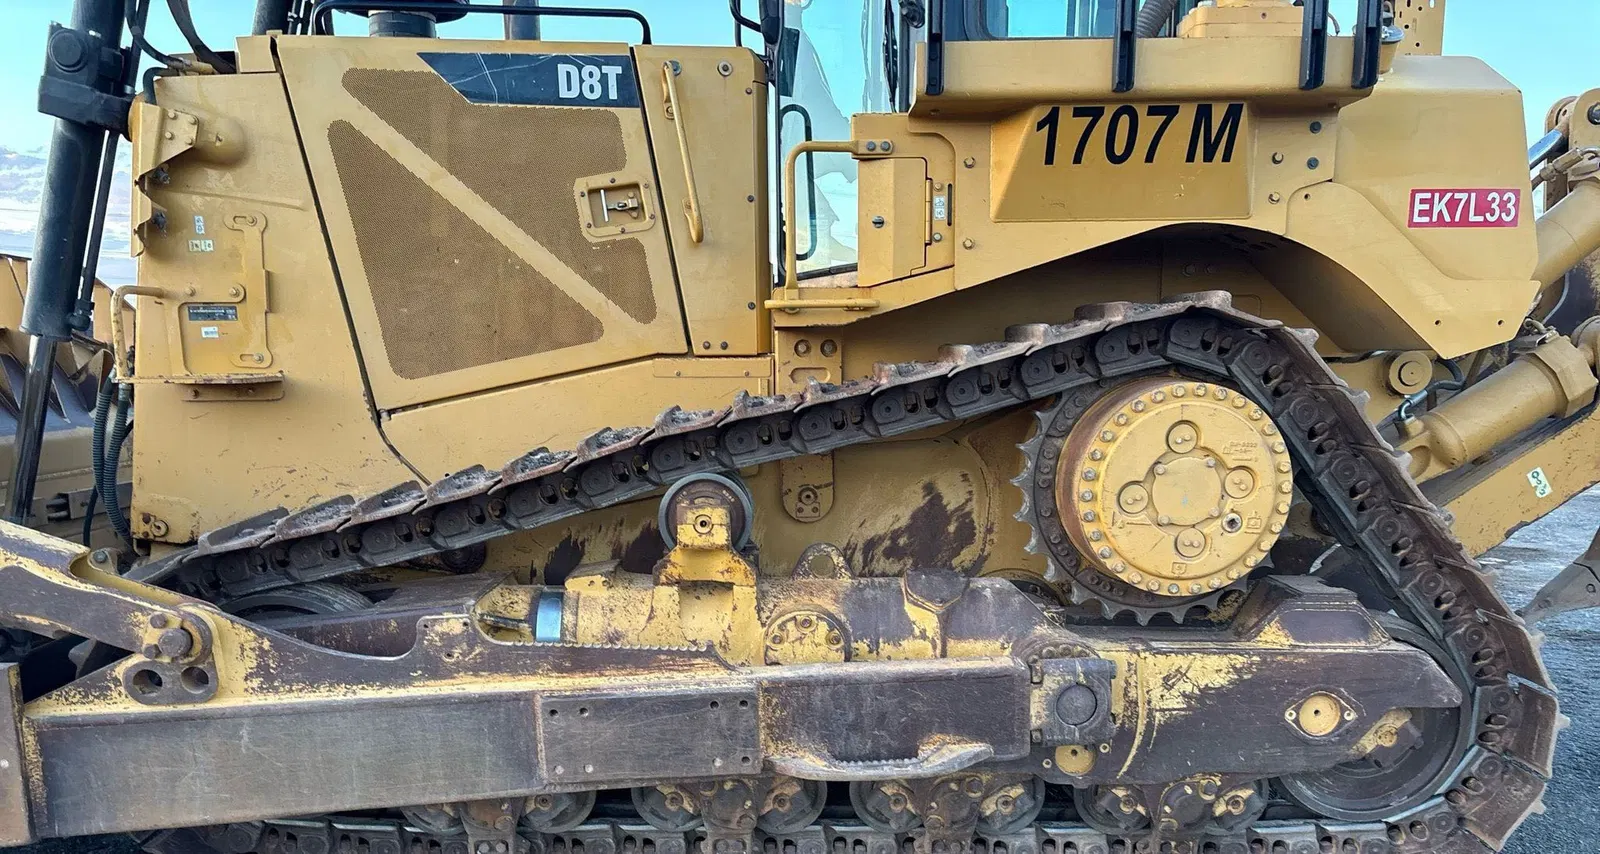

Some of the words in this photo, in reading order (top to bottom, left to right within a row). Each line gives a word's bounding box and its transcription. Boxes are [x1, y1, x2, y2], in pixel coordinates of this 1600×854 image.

[557, 64, 622, 100] D8T
[1036, 104, 1180, 165] 1707
[1185, 103, 1244, 163] M
[1412, 191, 1516, 223] EK7L33
